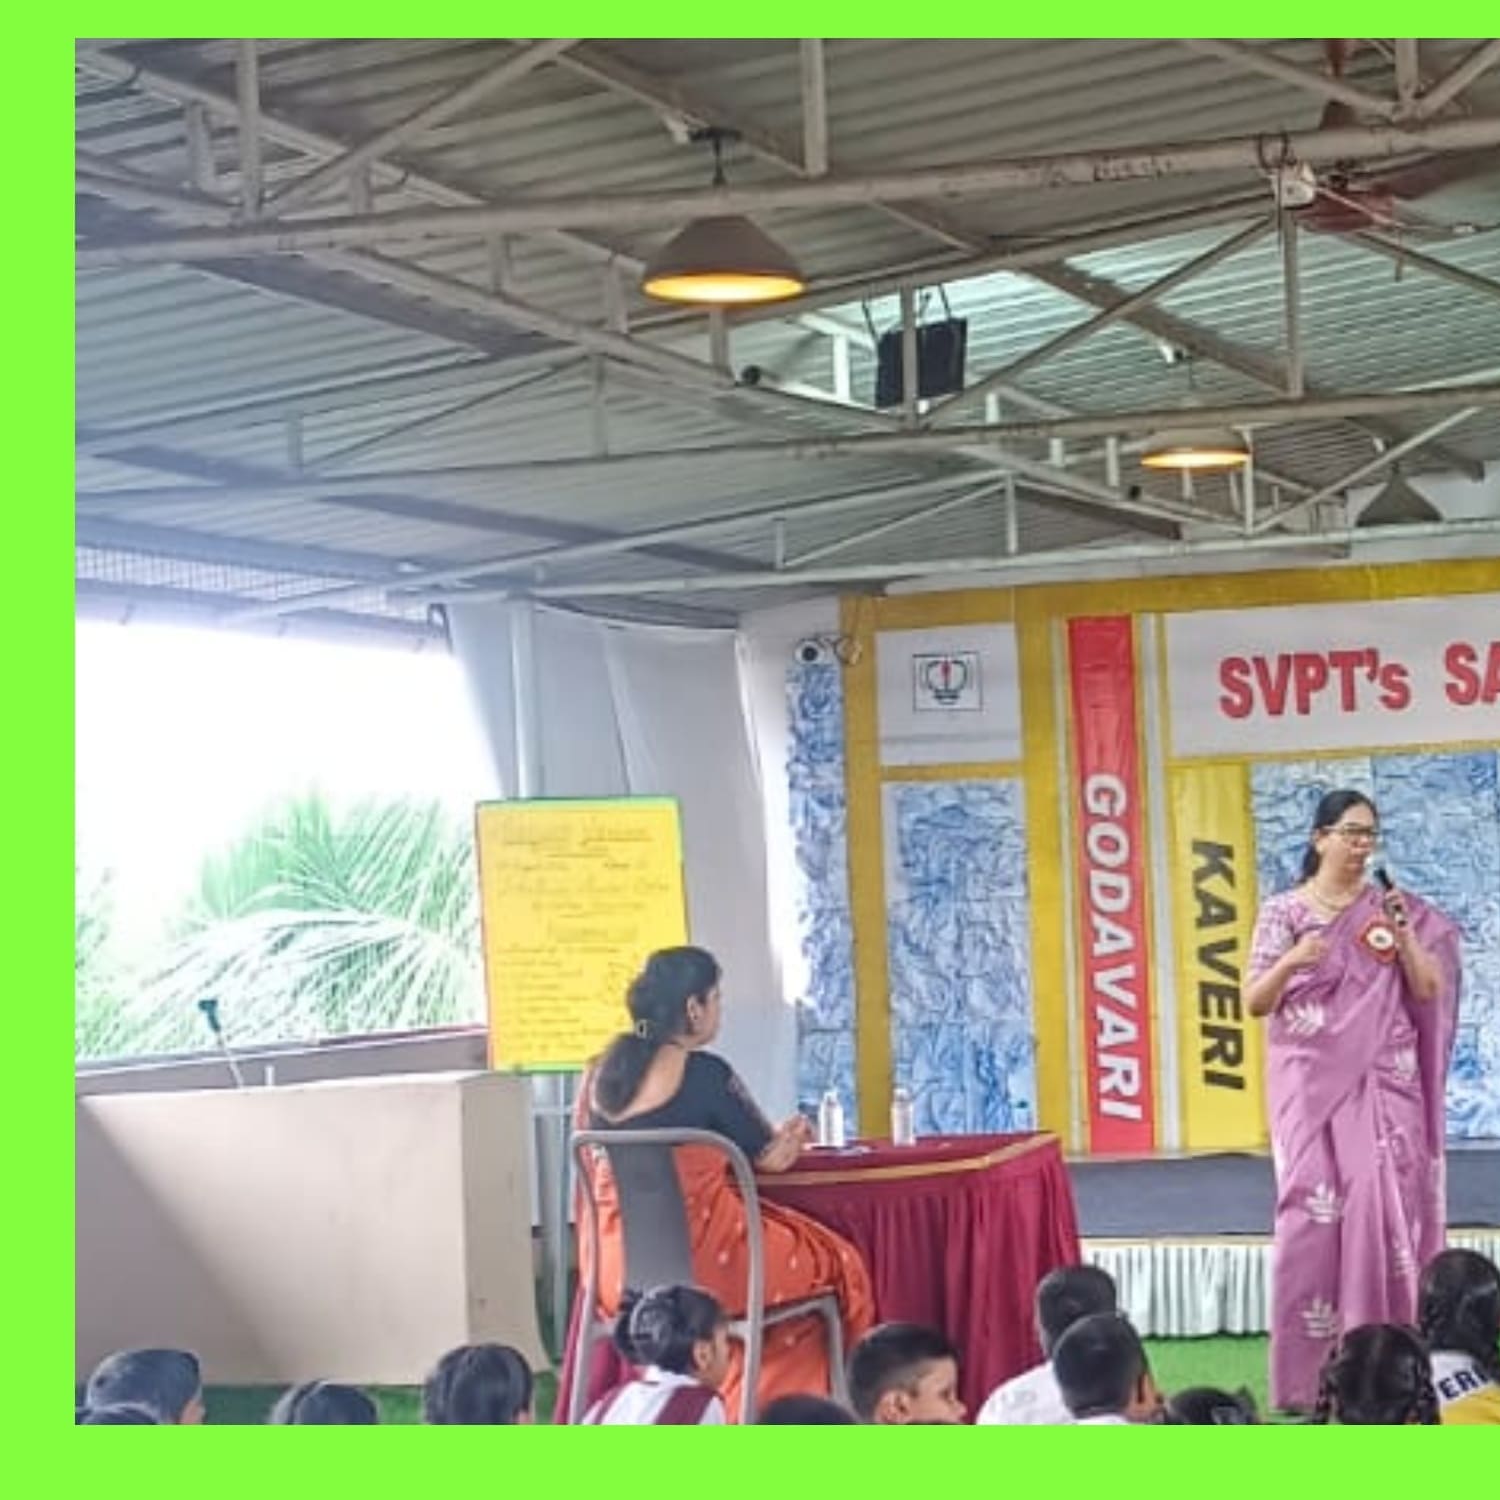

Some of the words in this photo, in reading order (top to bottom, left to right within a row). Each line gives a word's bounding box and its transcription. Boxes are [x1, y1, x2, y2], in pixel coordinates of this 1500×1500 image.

[1218, 648, 1412, 719] SVPT's
[1083, 772, 1143, 1121] GODAVARI
[1191, 837, 1246, 1091] KAVERI
